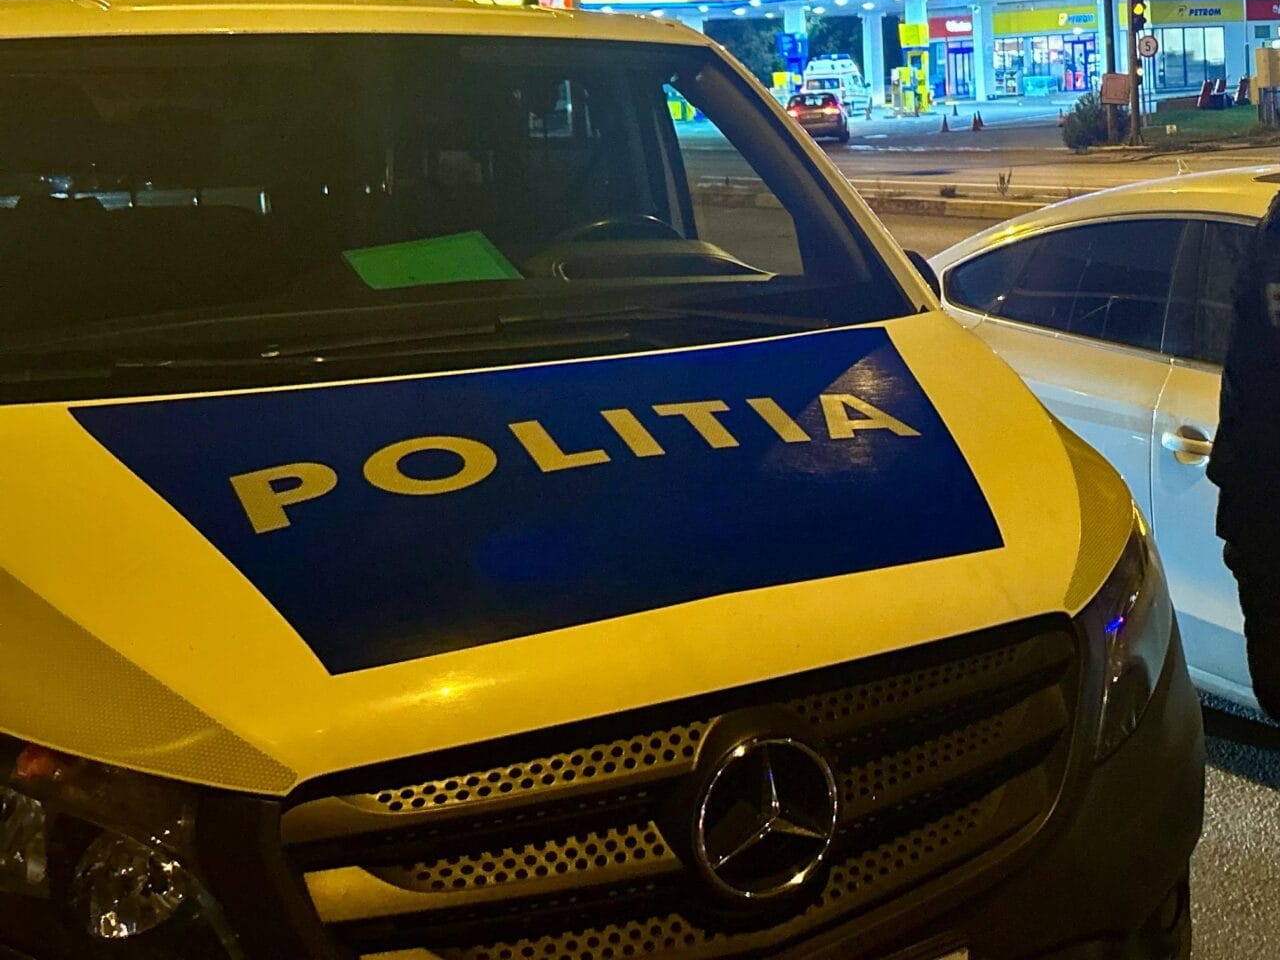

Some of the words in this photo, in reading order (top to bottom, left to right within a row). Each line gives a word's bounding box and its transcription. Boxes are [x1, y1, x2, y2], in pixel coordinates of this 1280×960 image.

[1188, 7, 1222, 17] PETROM
[1144, 41, 1151, 52] 5
[228, 392, 923, 535] POLITIA
